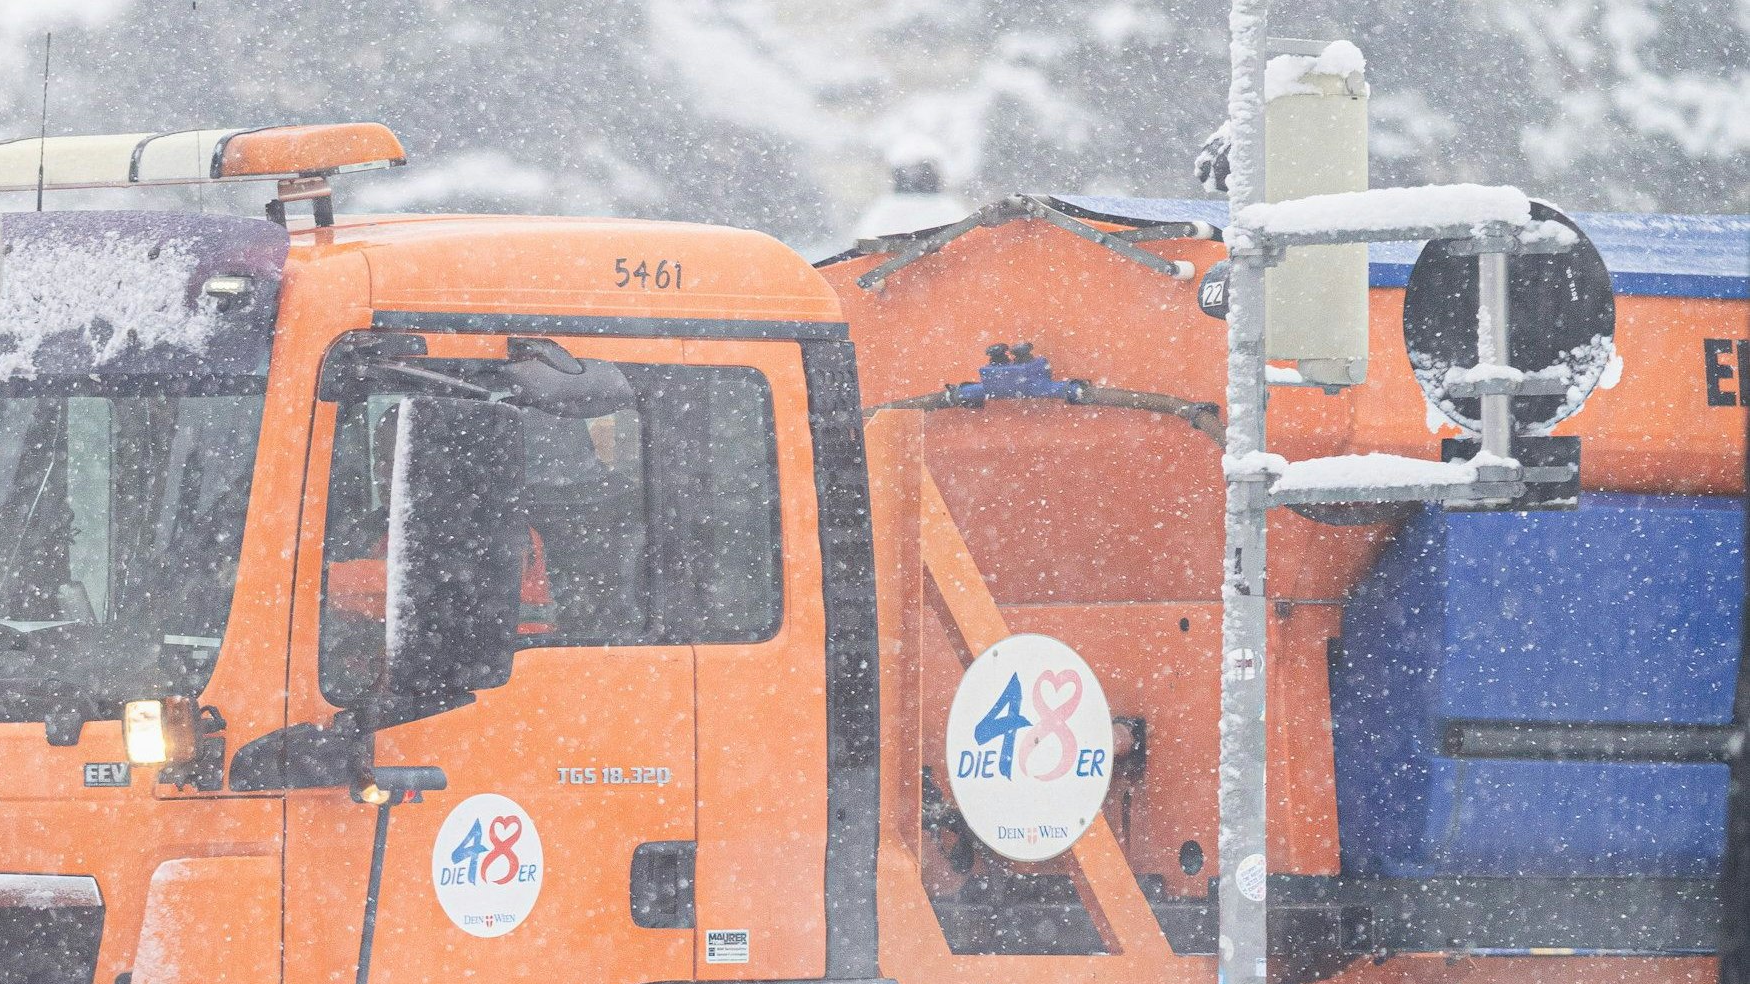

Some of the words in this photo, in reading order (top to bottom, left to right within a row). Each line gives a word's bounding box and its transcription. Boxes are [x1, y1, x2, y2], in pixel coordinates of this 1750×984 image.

[614, 257, 682, 289] 5461
[1204, 283, 1223, 306] 22
[85, 763, 128, 783] EEV
[957, 750, 997, 779] DIE
[556, 767, 597, 785] TGS
[601, 767, 672, 786] 18.320
[440, 866, 466, 886] DIE
[708, 933, 747, 942] MAURER
